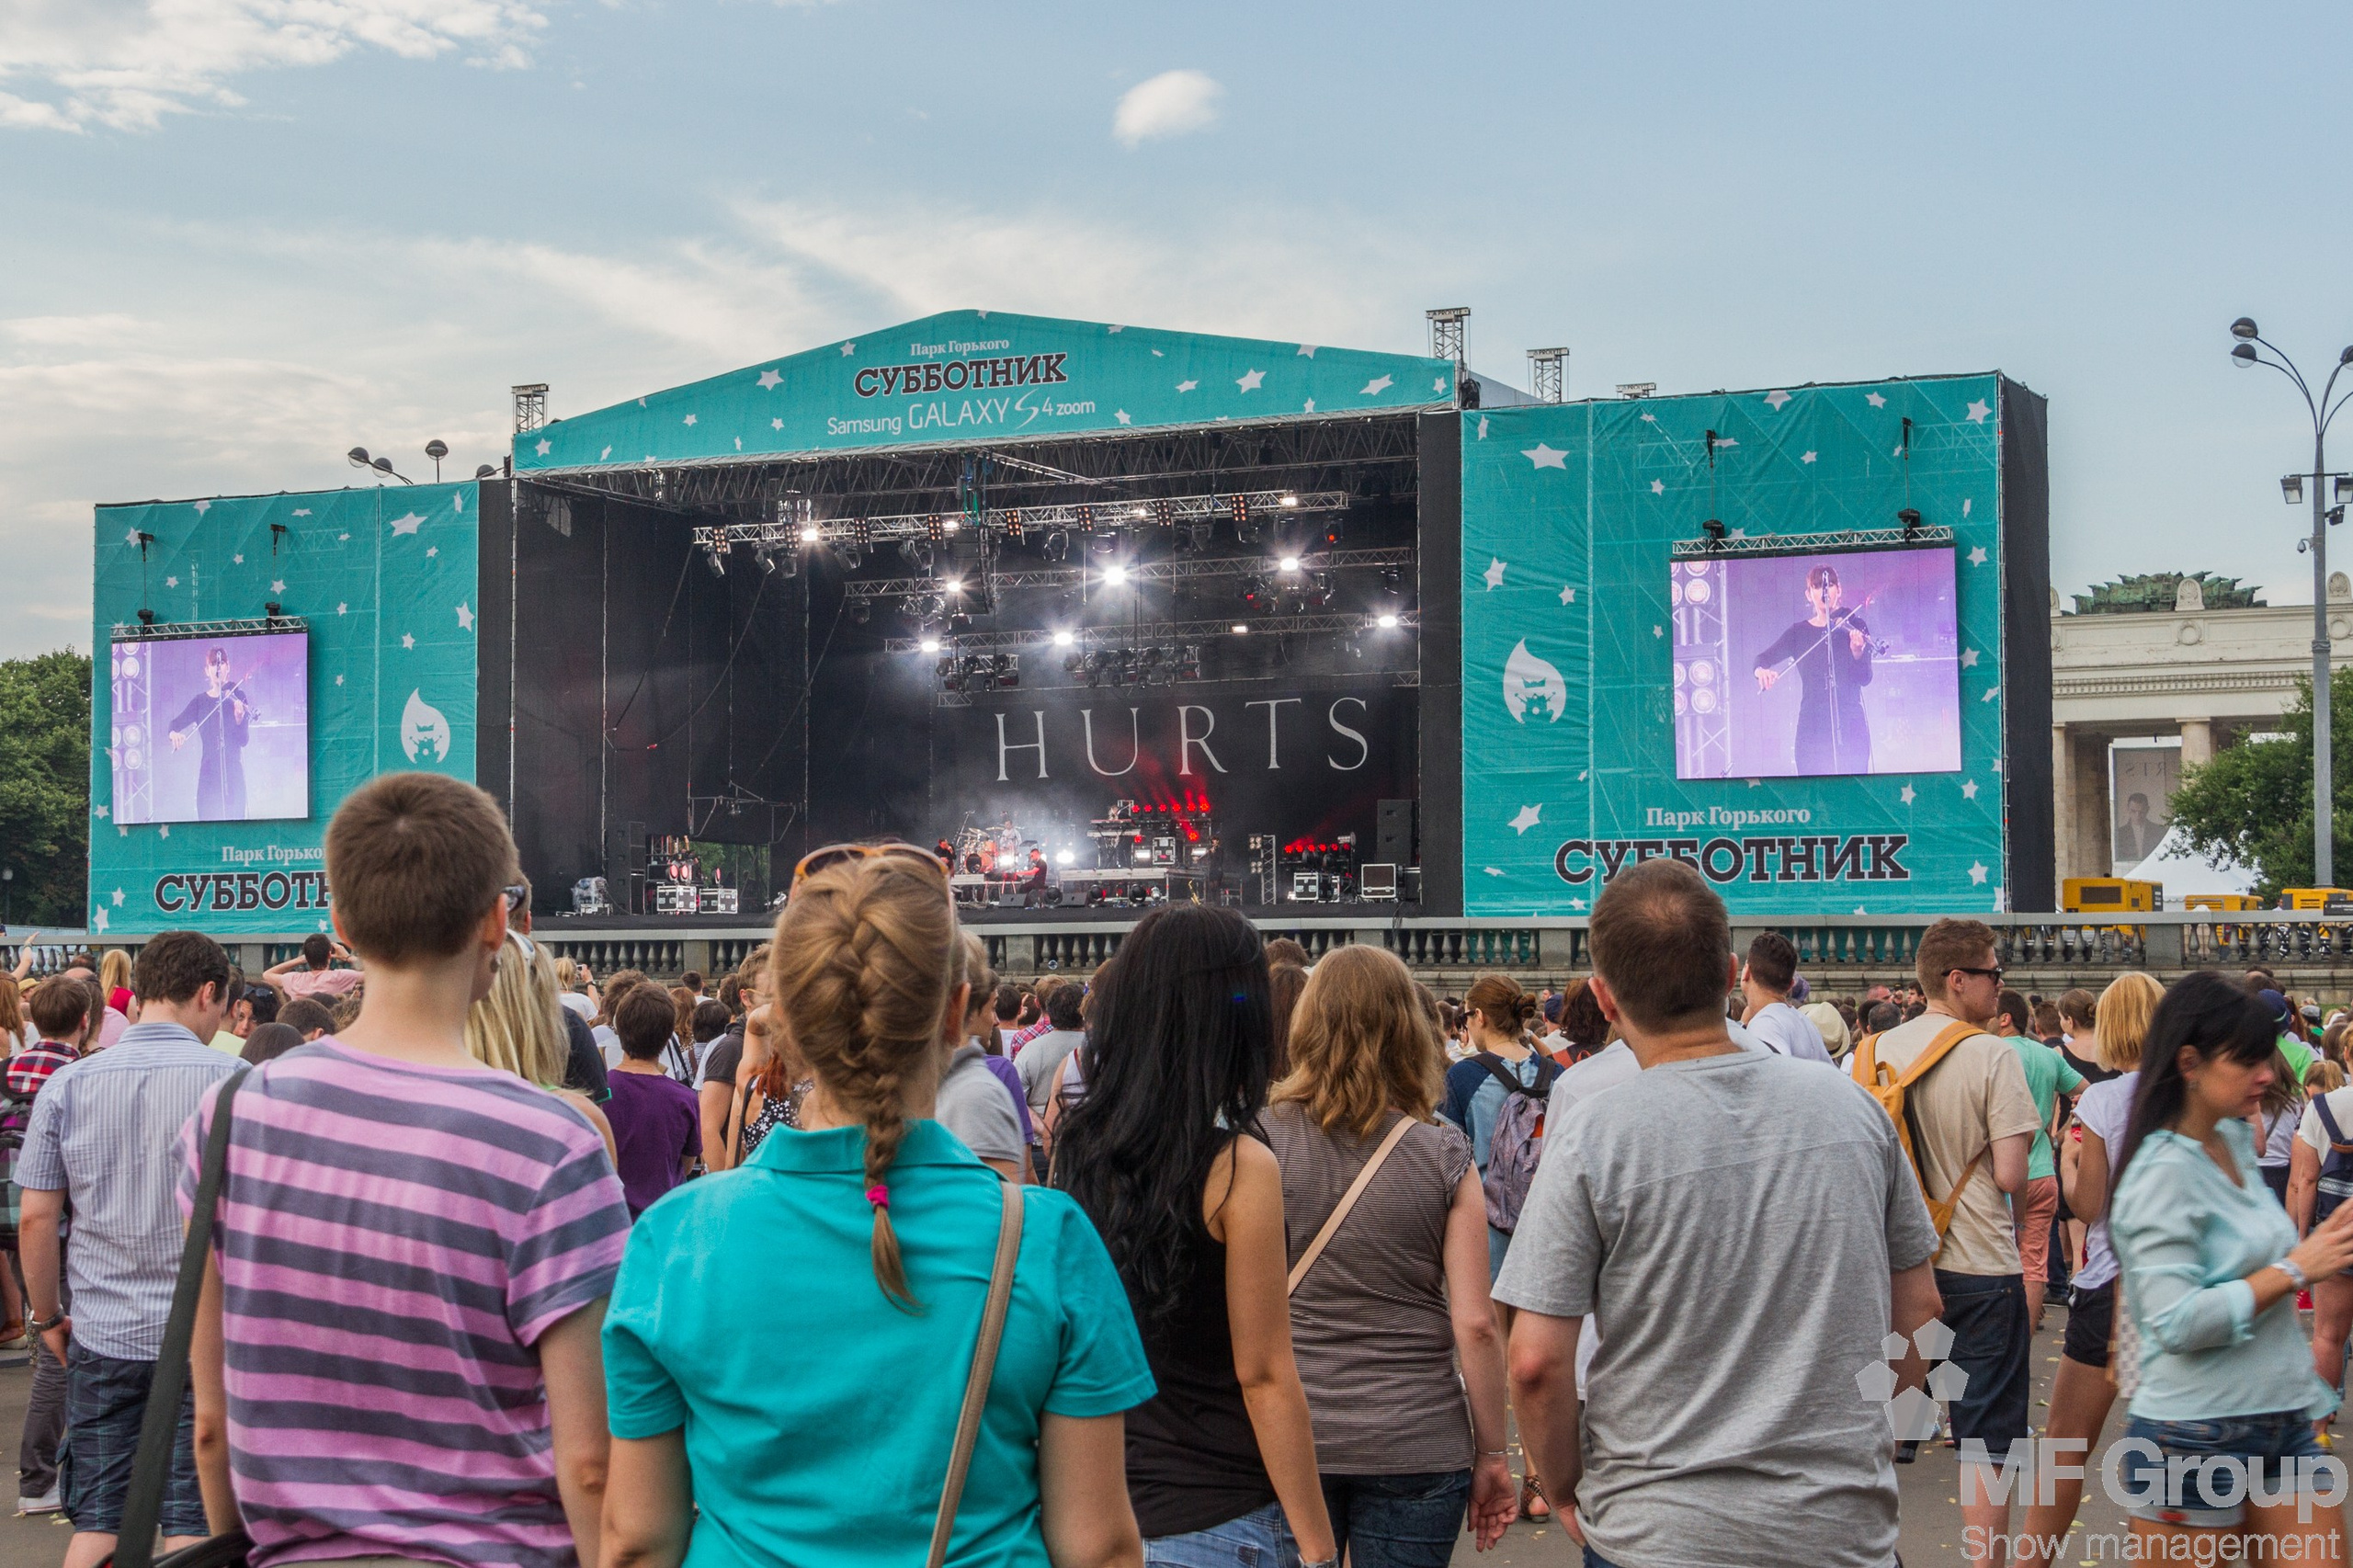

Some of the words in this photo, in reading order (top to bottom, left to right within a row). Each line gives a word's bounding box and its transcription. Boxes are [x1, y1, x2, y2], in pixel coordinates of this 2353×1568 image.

[911, 344, 946, 358] Парк
[948, 338, 1009, 355] Горького
[854, 352, 1068, 398] СУББОТНИК
[826, 415, 902, 436] Samsung
[908, 398, 1010, 429] GALAXY
[1056, 401, 1096, 416] zoom
[995, 697, 1369, 781] HURTS
[1645, 807, 1704, 832] Парк
[1708, 806, 1812, 831] Горького
[222, 846, 265, 867] Парк
[267, 845, 325, 866] Горько
[154, 871, 331, 913] СУББОТ
